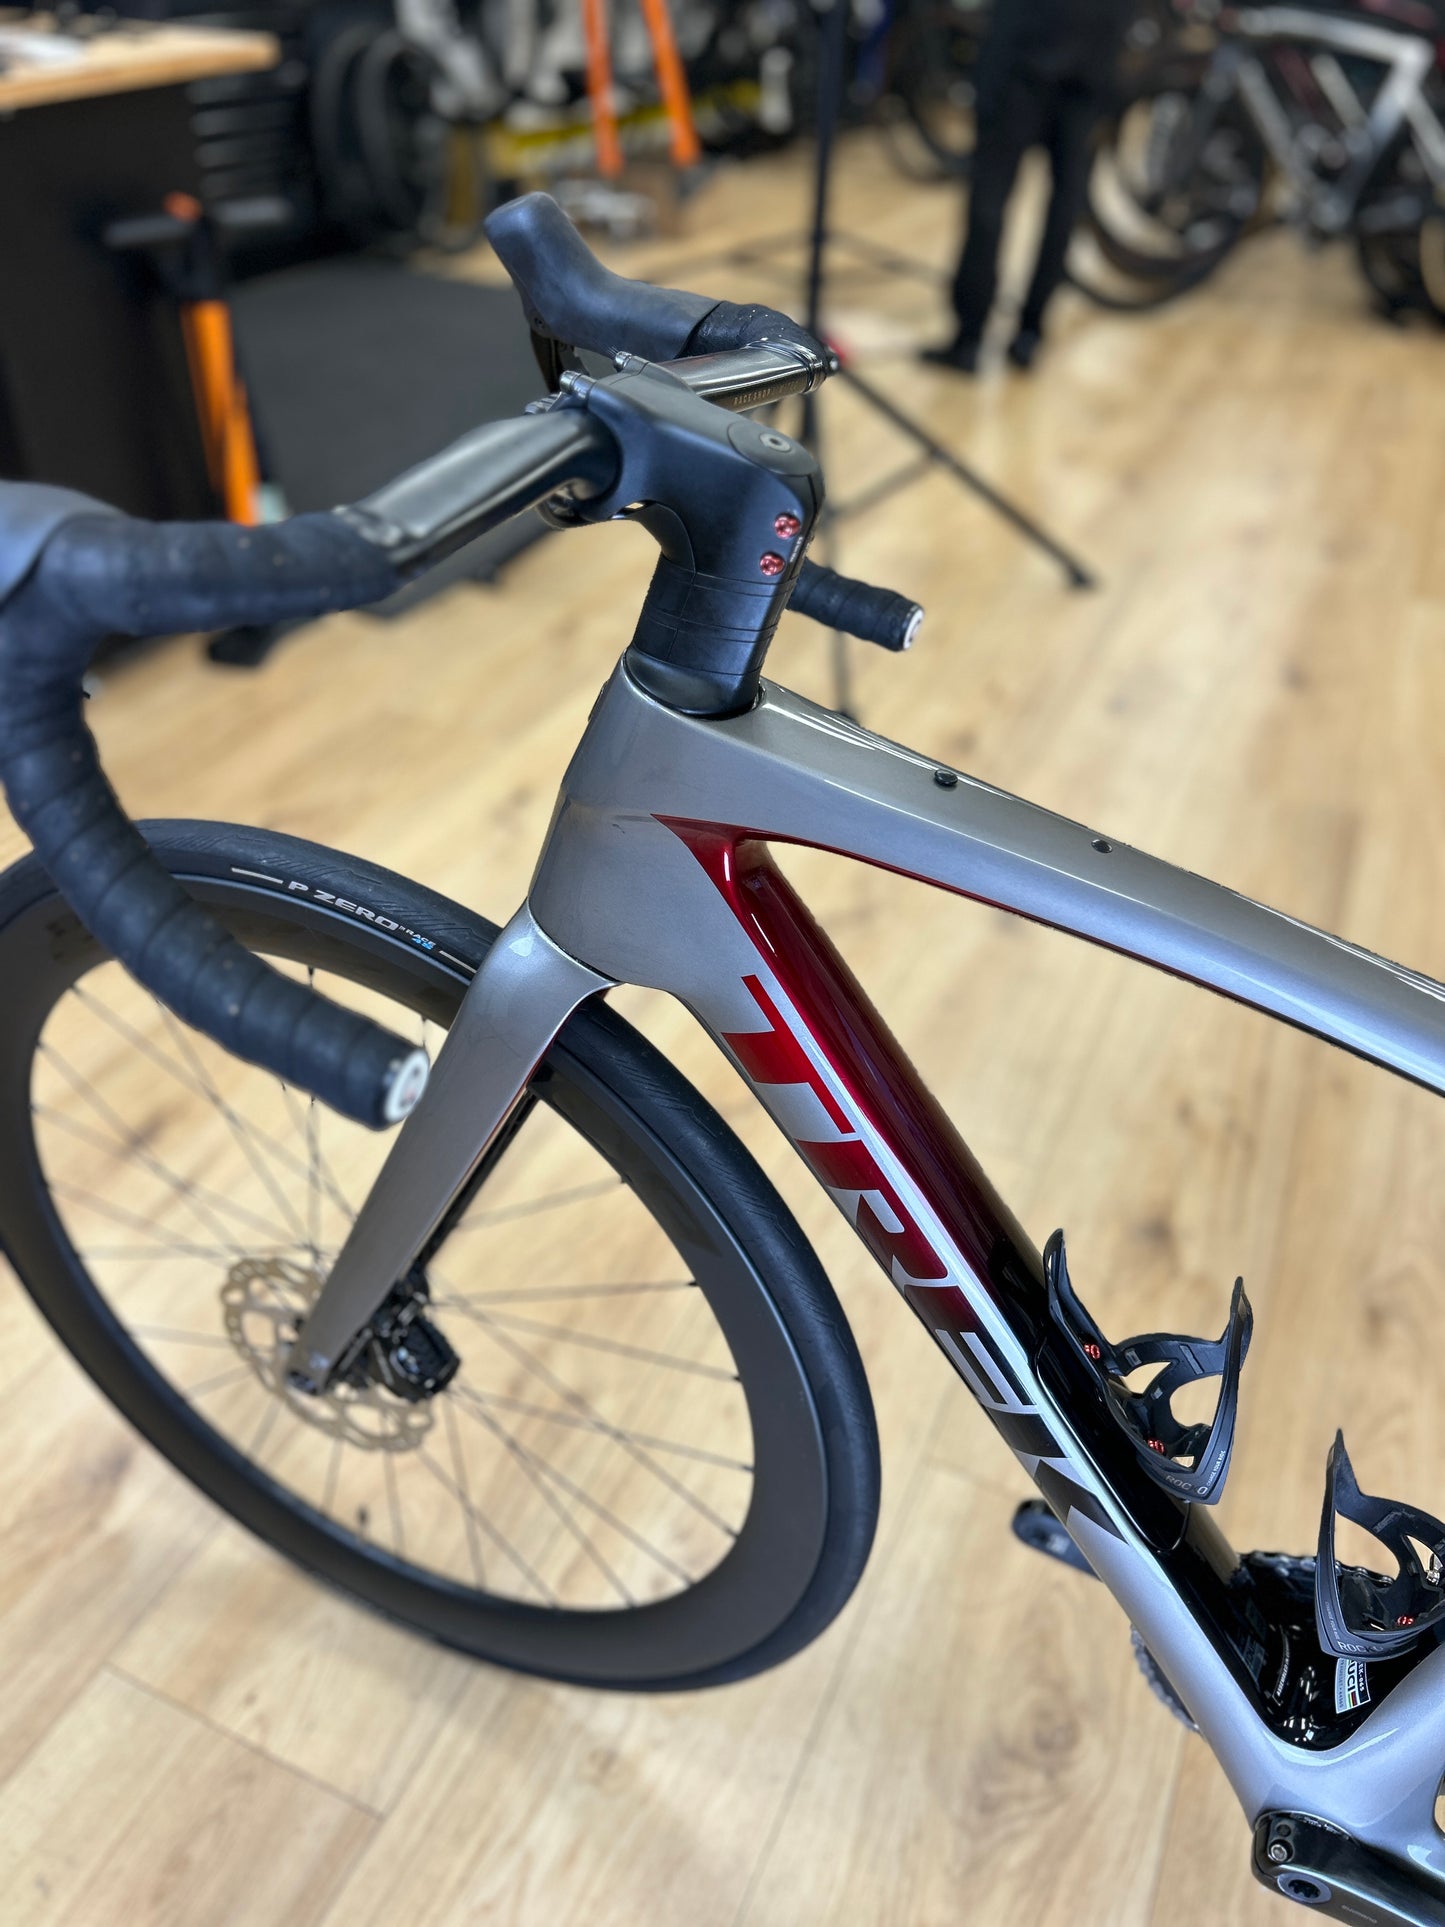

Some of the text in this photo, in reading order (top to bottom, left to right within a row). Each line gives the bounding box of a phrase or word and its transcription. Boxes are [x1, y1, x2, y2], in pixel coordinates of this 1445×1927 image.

[287, 881, 309, 892] P
[313, 889, 399, 931] ZERO
[720, 974, 1129, 1545] TREK
[1347, 1662, 1356, 1692] UCI
